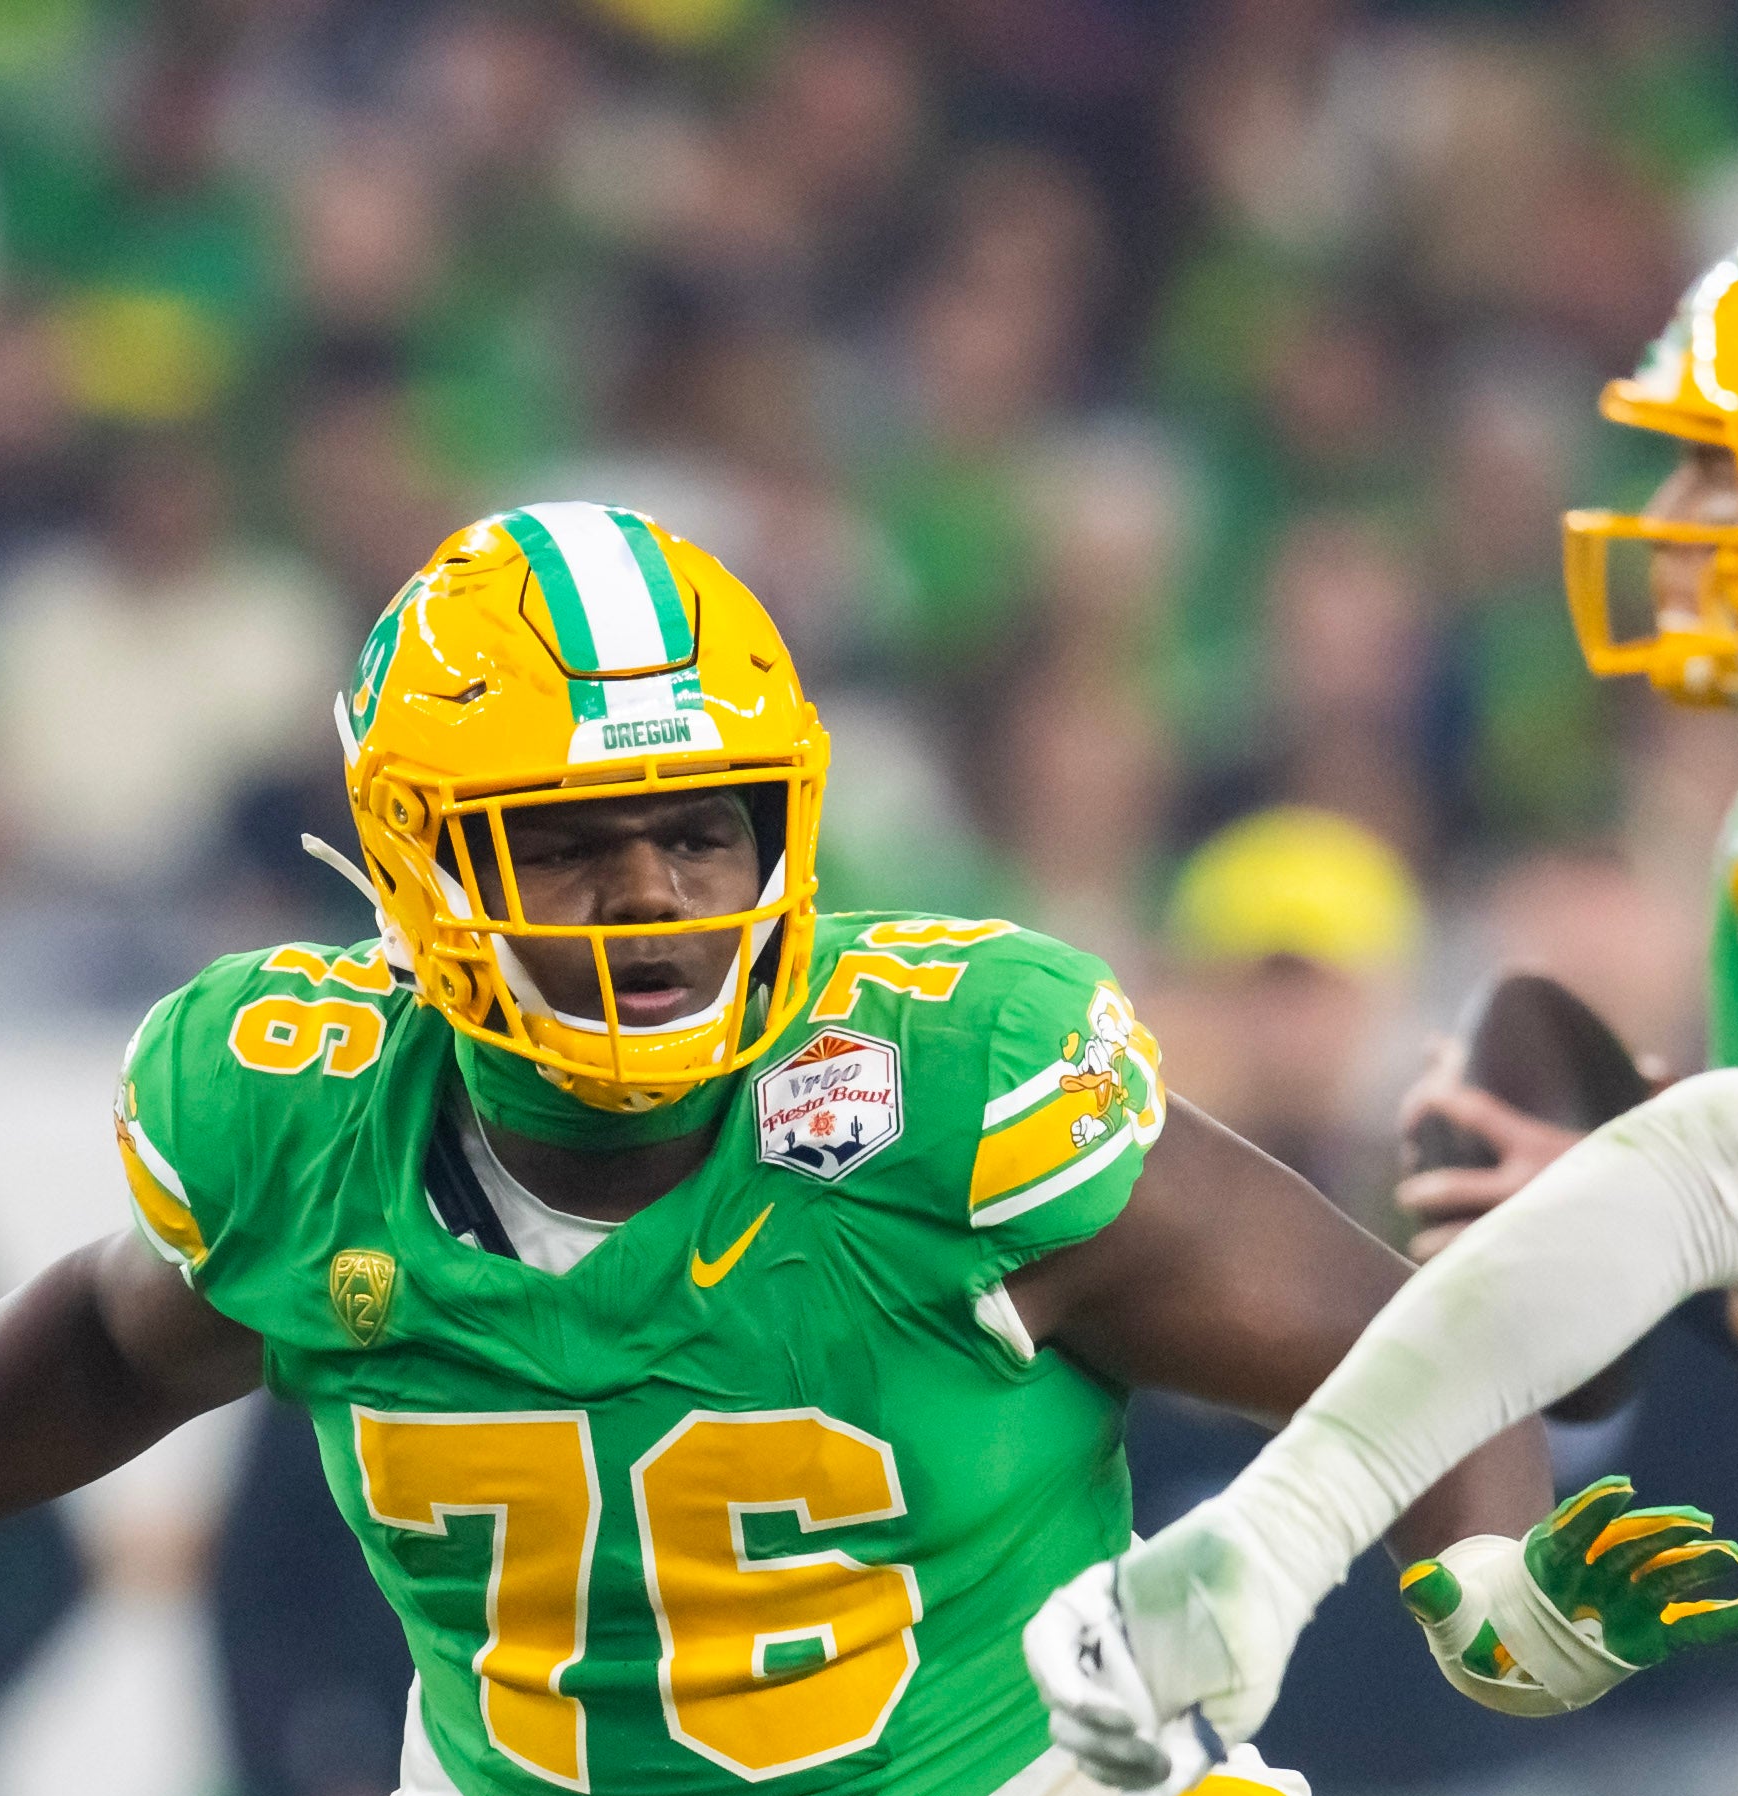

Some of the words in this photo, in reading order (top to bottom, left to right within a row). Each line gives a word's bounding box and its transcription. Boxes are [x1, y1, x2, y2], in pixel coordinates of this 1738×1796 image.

[603, 716, 692, 751] OREGON
[788, 1062, 863, 1099] Vrbo
[762, 1096, 825, 1134] Fiesta
[827, 1085, 892, 1106] Bowl
[334, 1255, 390, 1308] PAC
[345, 1293, 375, 1328] 12
[350, 1404, 923, 1795] 76
